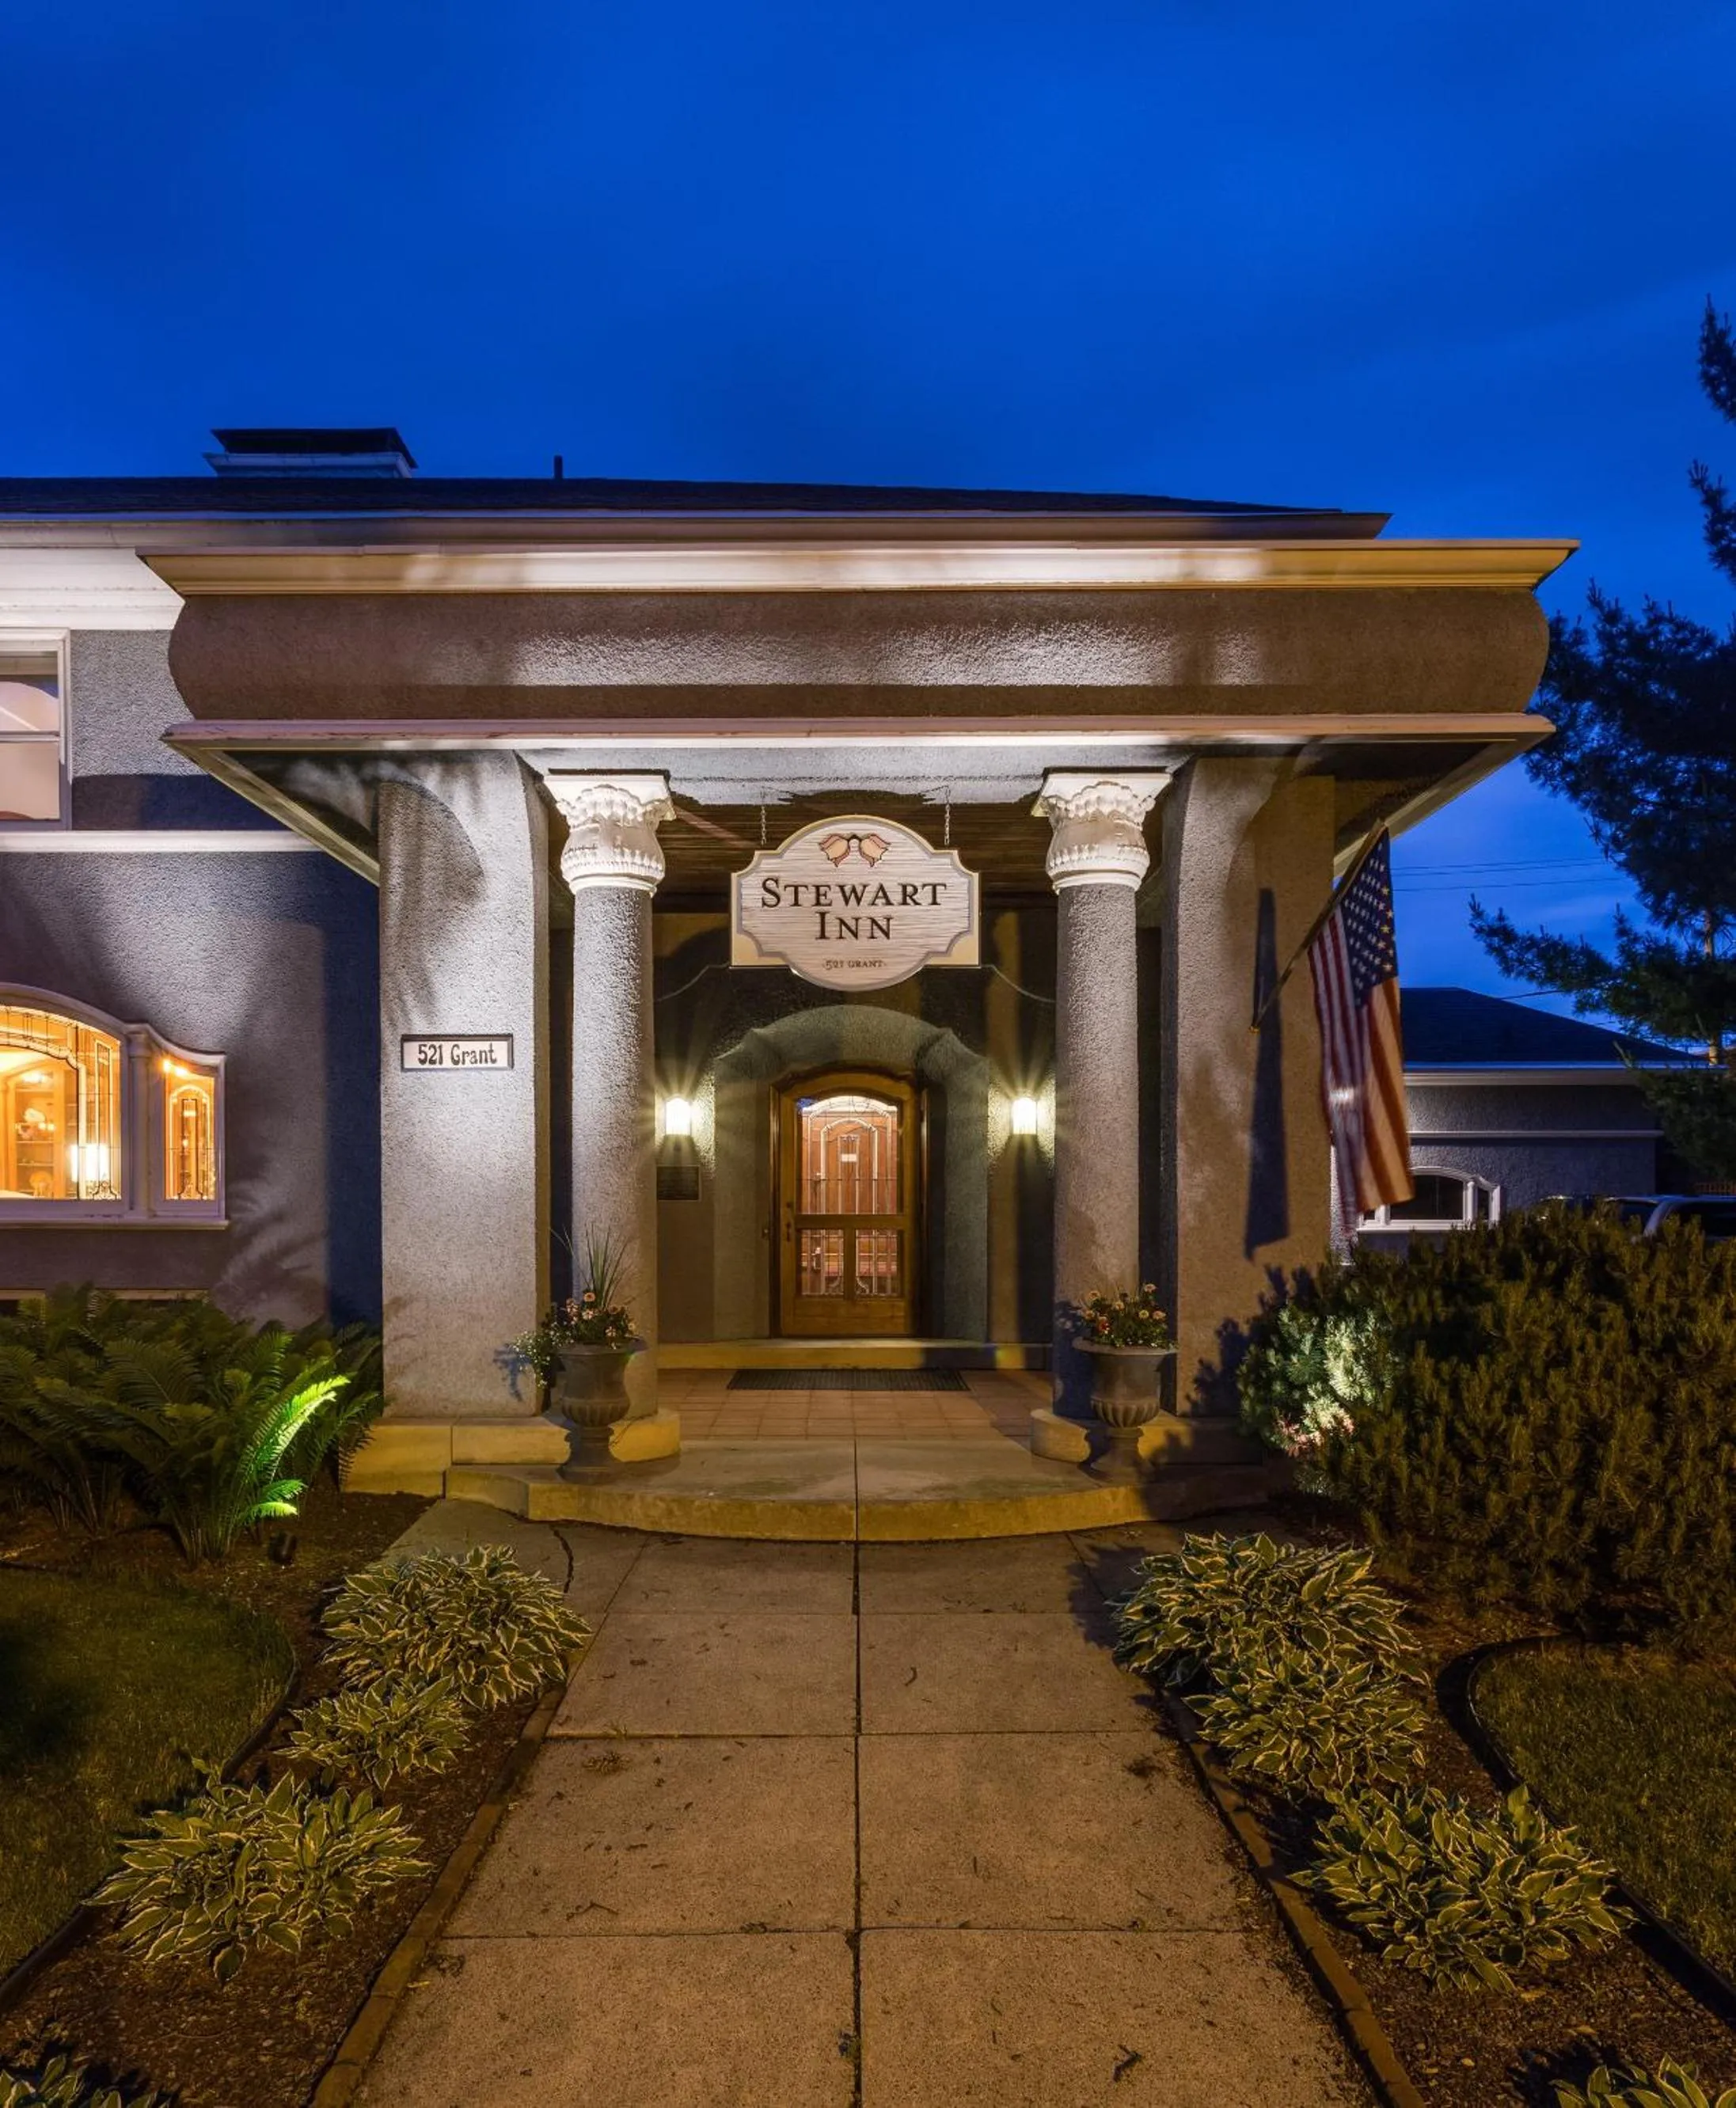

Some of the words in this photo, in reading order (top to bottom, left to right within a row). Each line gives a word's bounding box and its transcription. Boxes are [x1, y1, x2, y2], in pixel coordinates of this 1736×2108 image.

[761, 877, 947, 908] STEWART
[815, 911, 893, 940] INN
[847, 959, 883, 969] GRANT
[417, 1043, 443, 1065] 521
[450, 1043, 497, 1065] Grant
